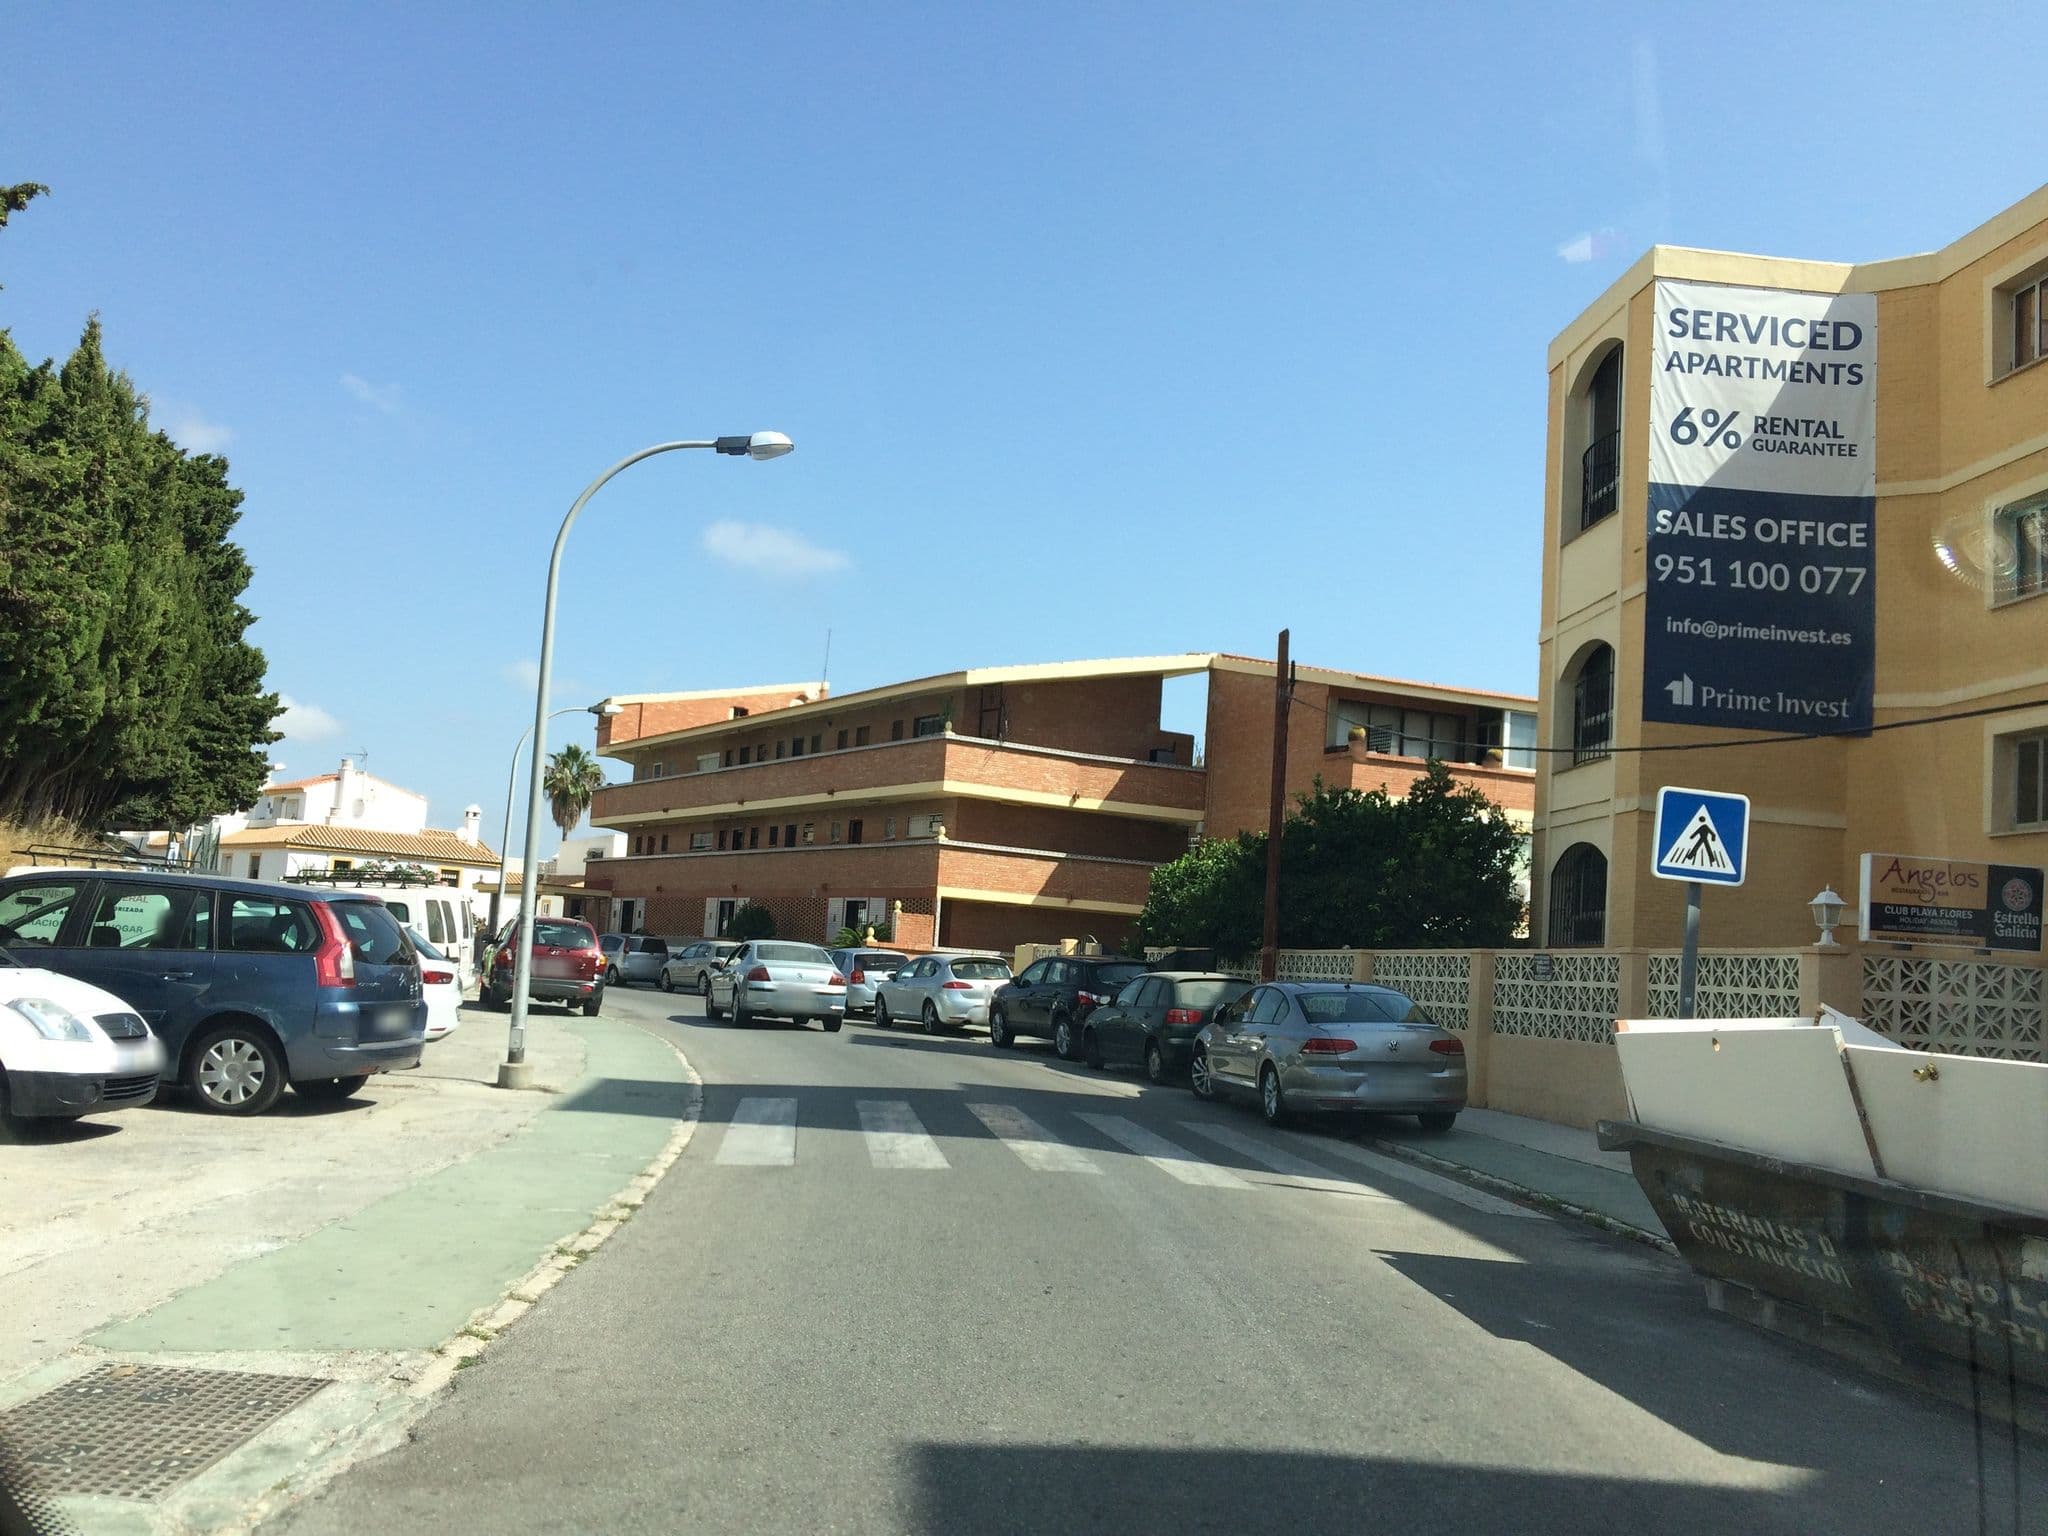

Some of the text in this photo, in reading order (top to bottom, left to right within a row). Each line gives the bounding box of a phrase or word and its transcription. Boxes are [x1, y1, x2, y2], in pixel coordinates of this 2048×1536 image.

[1668, 307, 1863, 351] SERVICED
[1664, 350, 1864, 386] APARTMENTS
[1670, 406, 1742, 450] 6%
[1754, 415, 1845, 439] RENTAL
[1752, 438, 1858, 457] GUARANTEE
[1655, 509, 1868, 548] SALES OFFICE
[1654, 553, 1867, 596] 951 100 077
[1666, 616, 1852, 645] info@primeinvest.es
[1701, 685, 1850, 719] Prime Invest
[1880, 857, 1980, 903] Angelos
[1884, 904, 1974, 920] CLUB PLAYA FLORES
[1993, 910, 2040, 926] Estrella
[1994, 923, 2037, 939] Galicia
